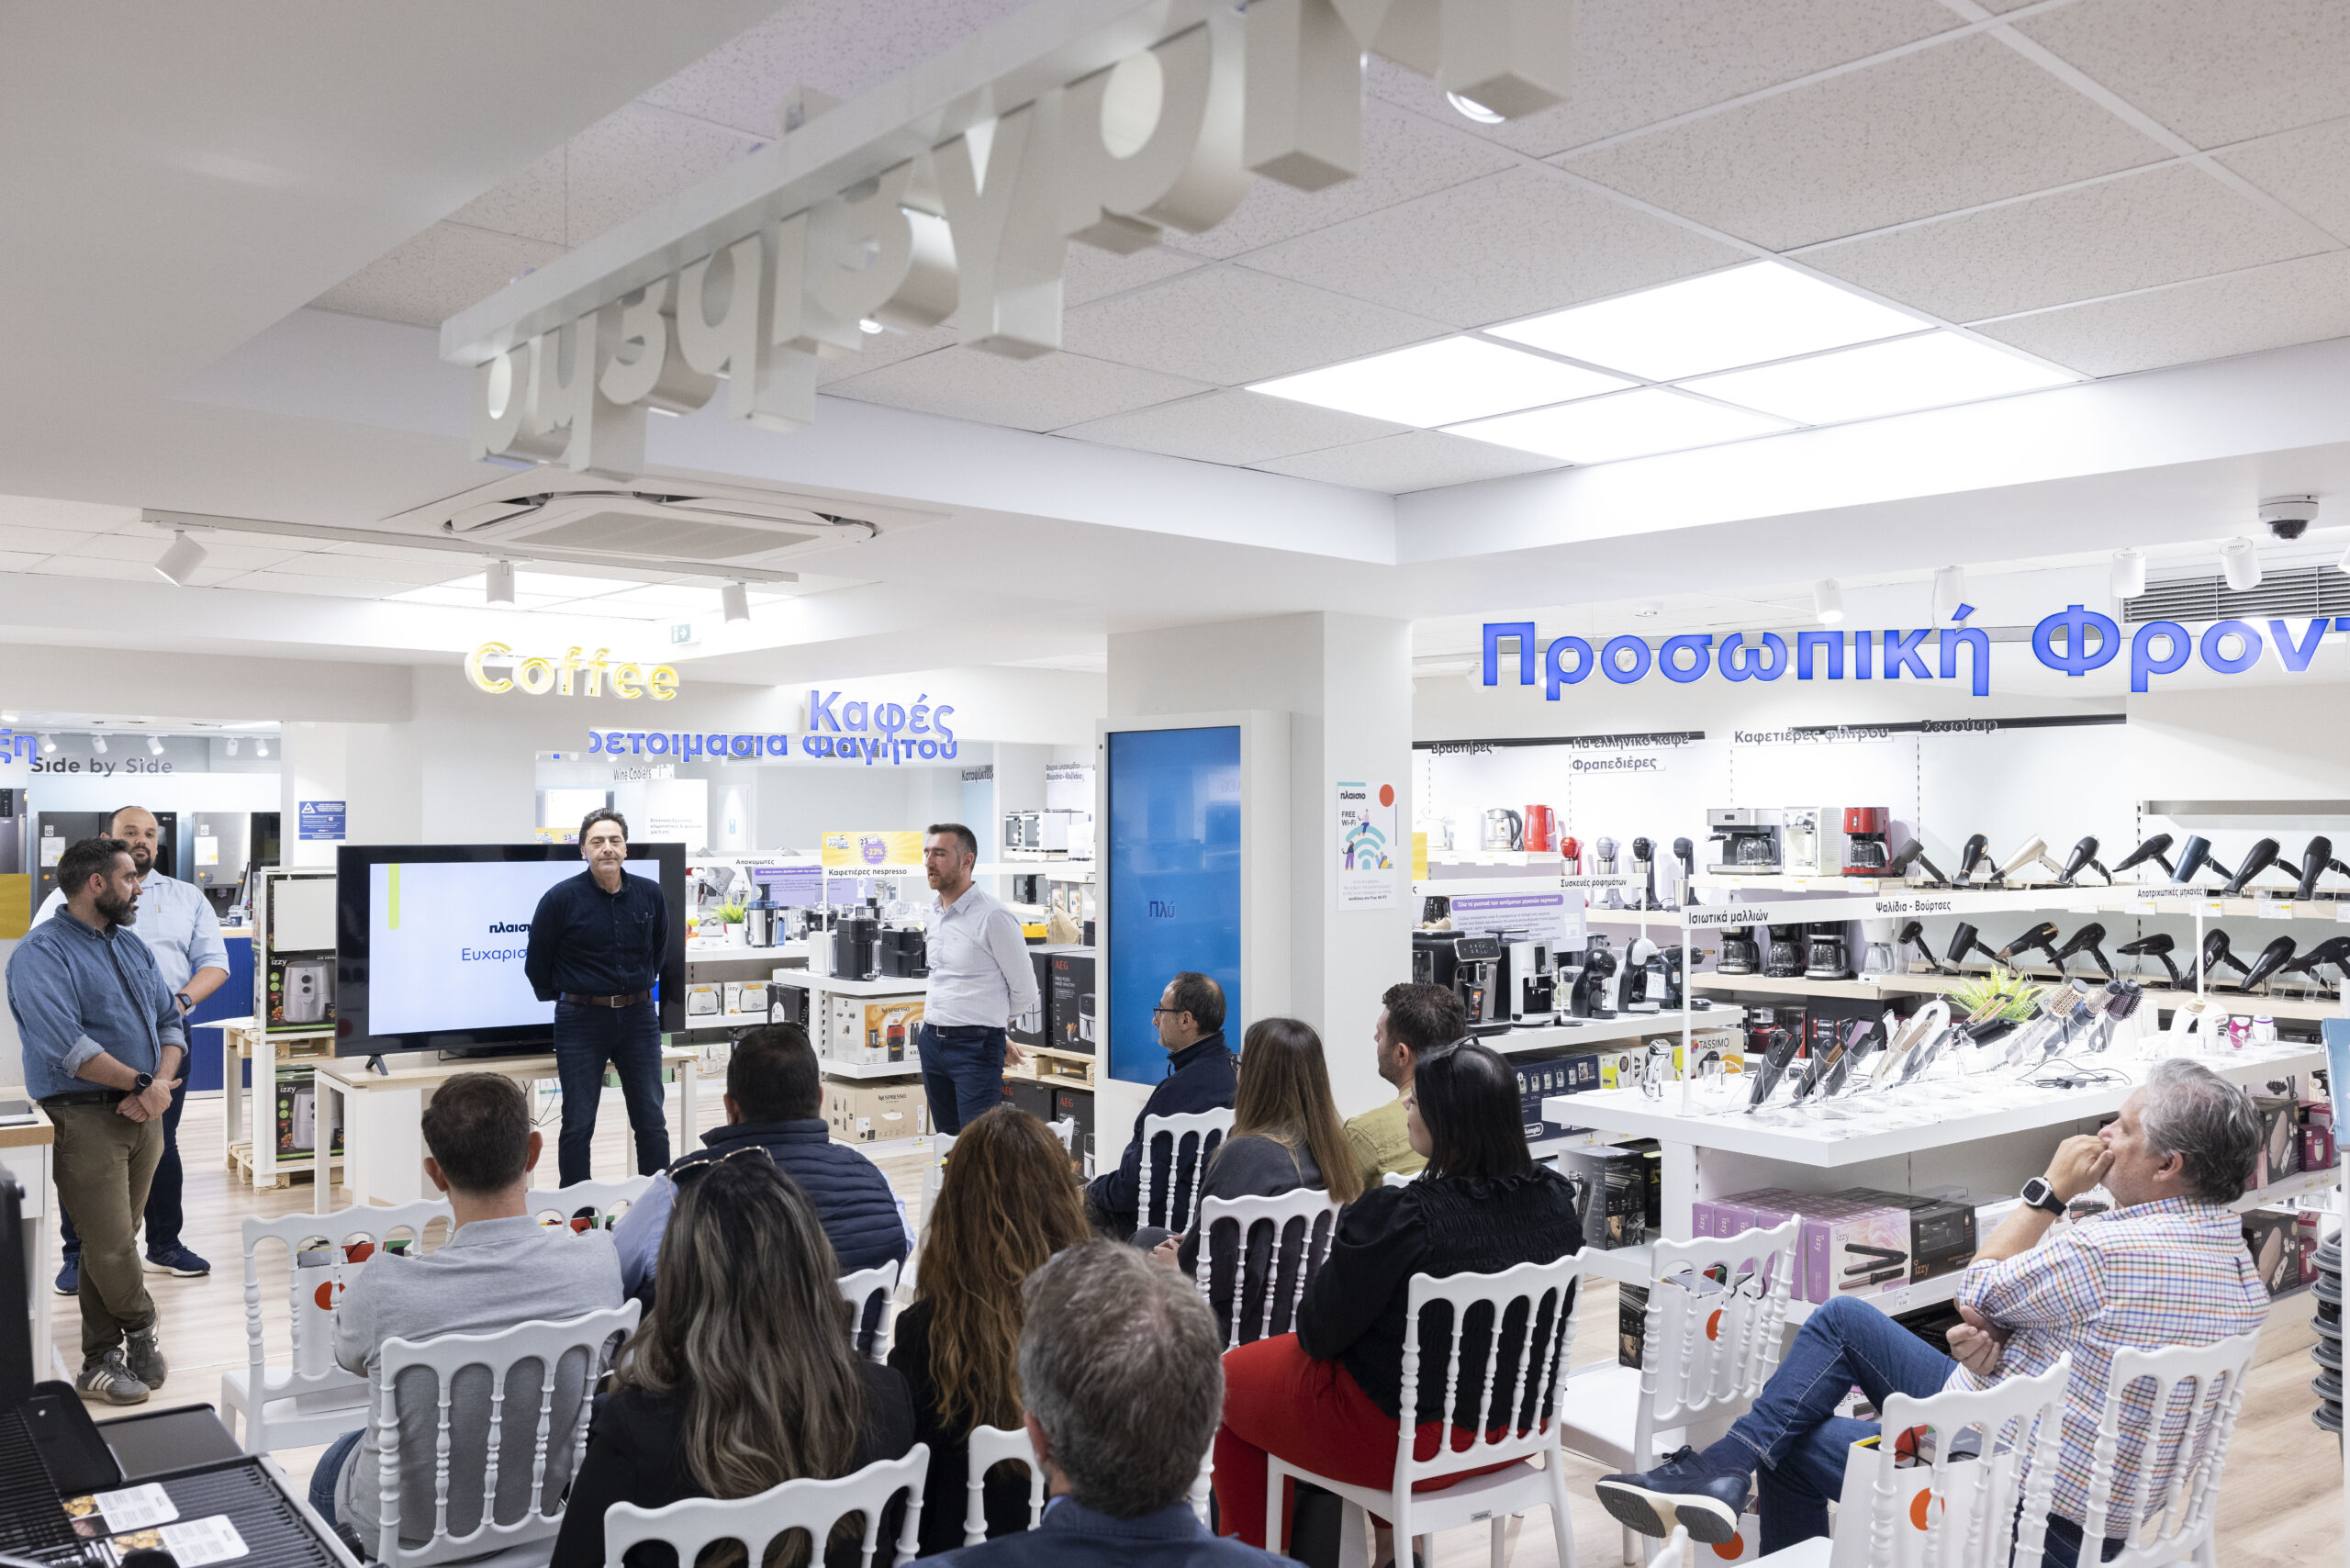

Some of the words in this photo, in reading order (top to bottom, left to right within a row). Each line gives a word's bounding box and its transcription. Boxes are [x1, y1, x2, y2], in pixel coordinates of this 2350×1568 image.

[1482, 603, 1991, 701] Προσωπική
[465, 642, 679, 701] Coffee
[810, 690, 956, 743] Καφές
[1734, 727, 1819, 745] Καφετιέρες
[1823, 724, 1889, 743] φίλτρου
[1431, 740, 1494, 756] Βραστήρες
[1654, 731, 1692, 746] καφέ
[31, 757, 81, 774] Side
[90, 757, 117, 778] by
[125, 757, 173, 774] Side
[1572, 755, 1658, 773] Φραπεδιέρες
[613, 768, 628, 780] Wine
[629, 767, 652, 779] Coolers
[1340, 790, 1366, 800] πλαισιο
[859, 837, 868, 846] 23
[828, 868, 870, 877] Καφετιέρες
[872, 868, 907, 876] nespresso
[1561, 878, 1590, 888] Συσκευές
[1591, 877, 1628, 888] ροφημάτων
[2137, 887, 2179, 898] Αποτριχωτικές
[2180, 887, 2204, 898] μηχανές
[1149, 901, 1176, 919] Πλύ
[1875, 900, 1908, 913] Ψαλίδια
[1915, 900, 1952, 913] Βούρτσες
[1688, 911, 1728, 924] Ισιωτικά
[1730, 909, 1769, 924] μαλλιών
[271, 958, 287, 967] izzy
[1055, 960, 1069, 970] AEG
[1698, 1037, 1730, 1049] TASSIMO
[1001, 1086, 1013, 1096] AEG
[1059, 1096, 1074, 1108] AEG
[1814, 1235, 1822, 1252] izzy
[1836, 1234, 1850, 1242] izzy
[1915, 1262, 1930, 1277] izzy
